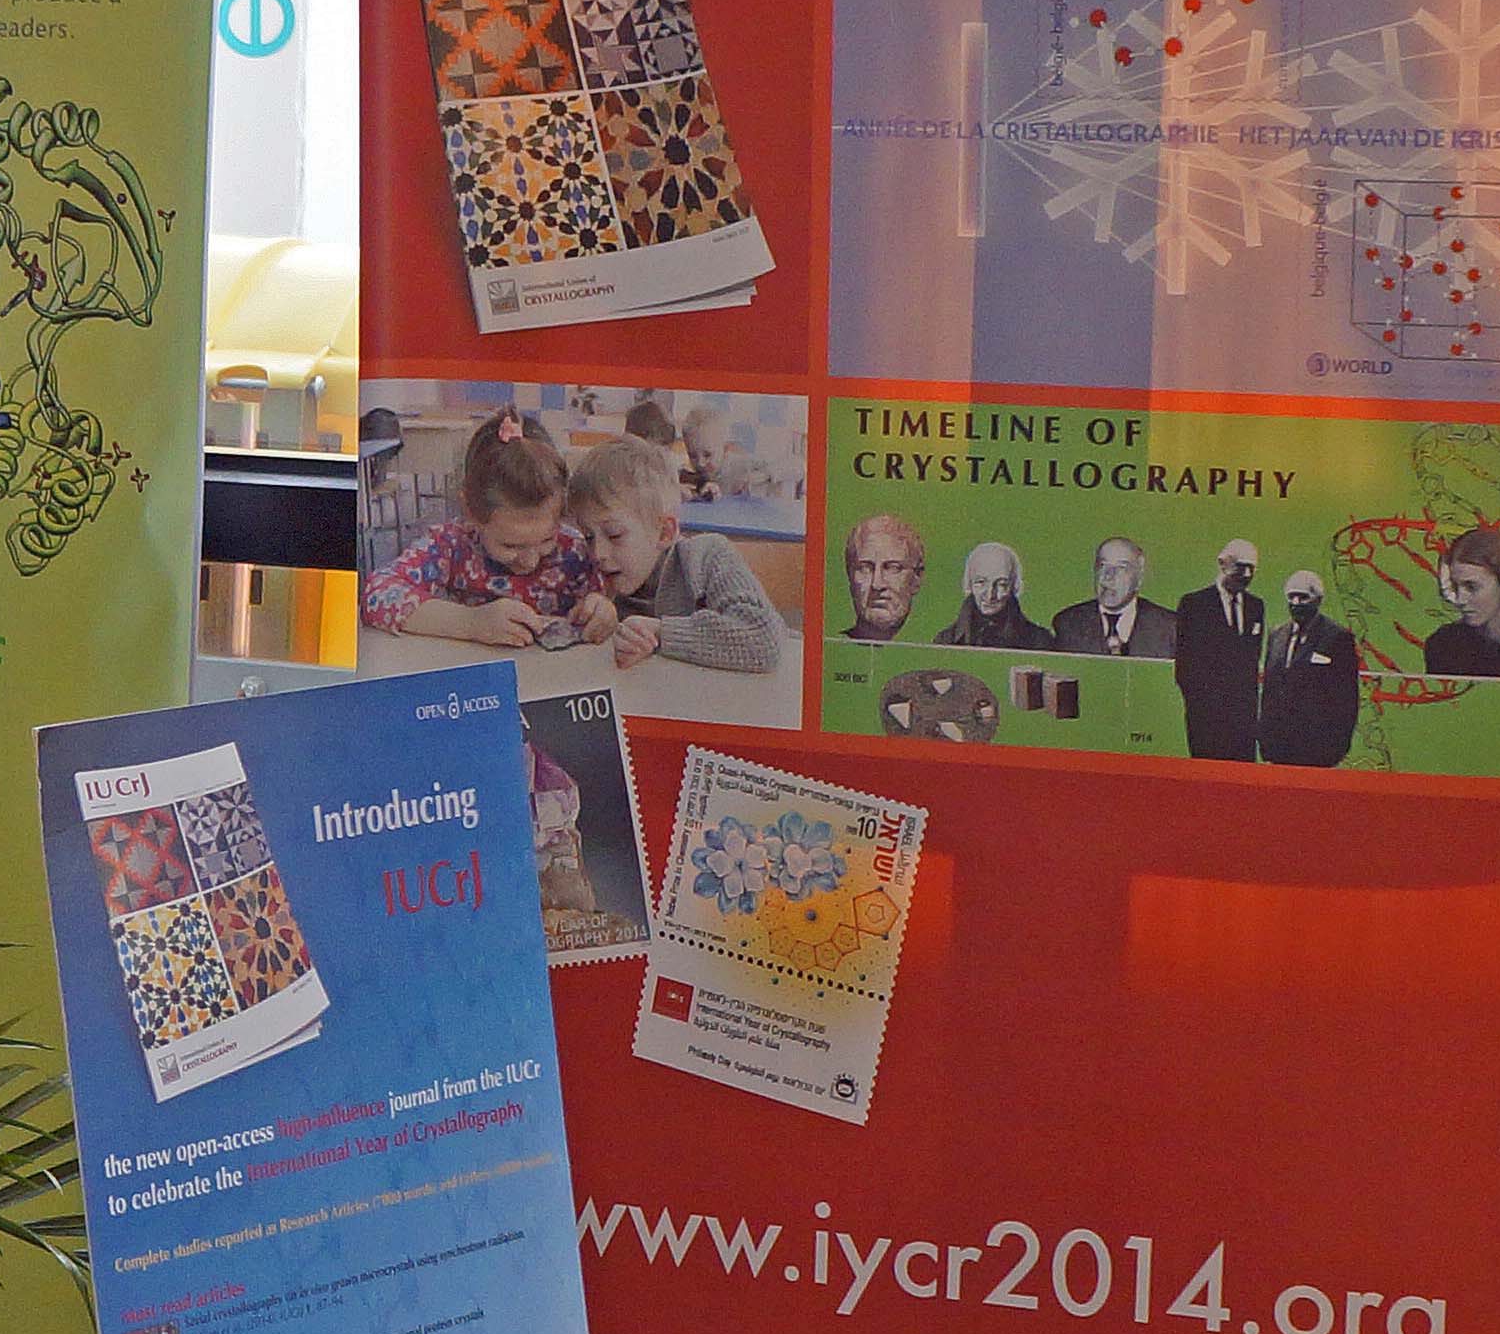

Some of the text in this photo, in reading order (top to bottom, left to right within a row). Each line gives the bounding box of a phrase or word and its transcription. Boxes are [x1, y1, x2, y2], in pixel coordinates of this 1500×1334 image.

[855, 408, 1141, 445] TIMELINE OF
[854, 452, 1294, 498] CRYSTALLOGRAPHY
[416, 695, 500, 719] OPEN ACCESS
[564, 695, 610, 724] 100
[85, 772, 151, 800] IUCrJ
[314, 782, 478, 841] Introducing
[857, 816, 877, 840] 10
[383, 850, 483, 916] IUCrJ
[104, 1153, 132, 1179] the
[136, 1149, 172, 1172] new
[176, 1123, 275, 1167] open-access
[388, 1081, 439, 1117] journal
[443, 1077, 477, 1100] from
[480, 1068, 503, 1090] the
[505, 1060, 542, 1082] IUCr
